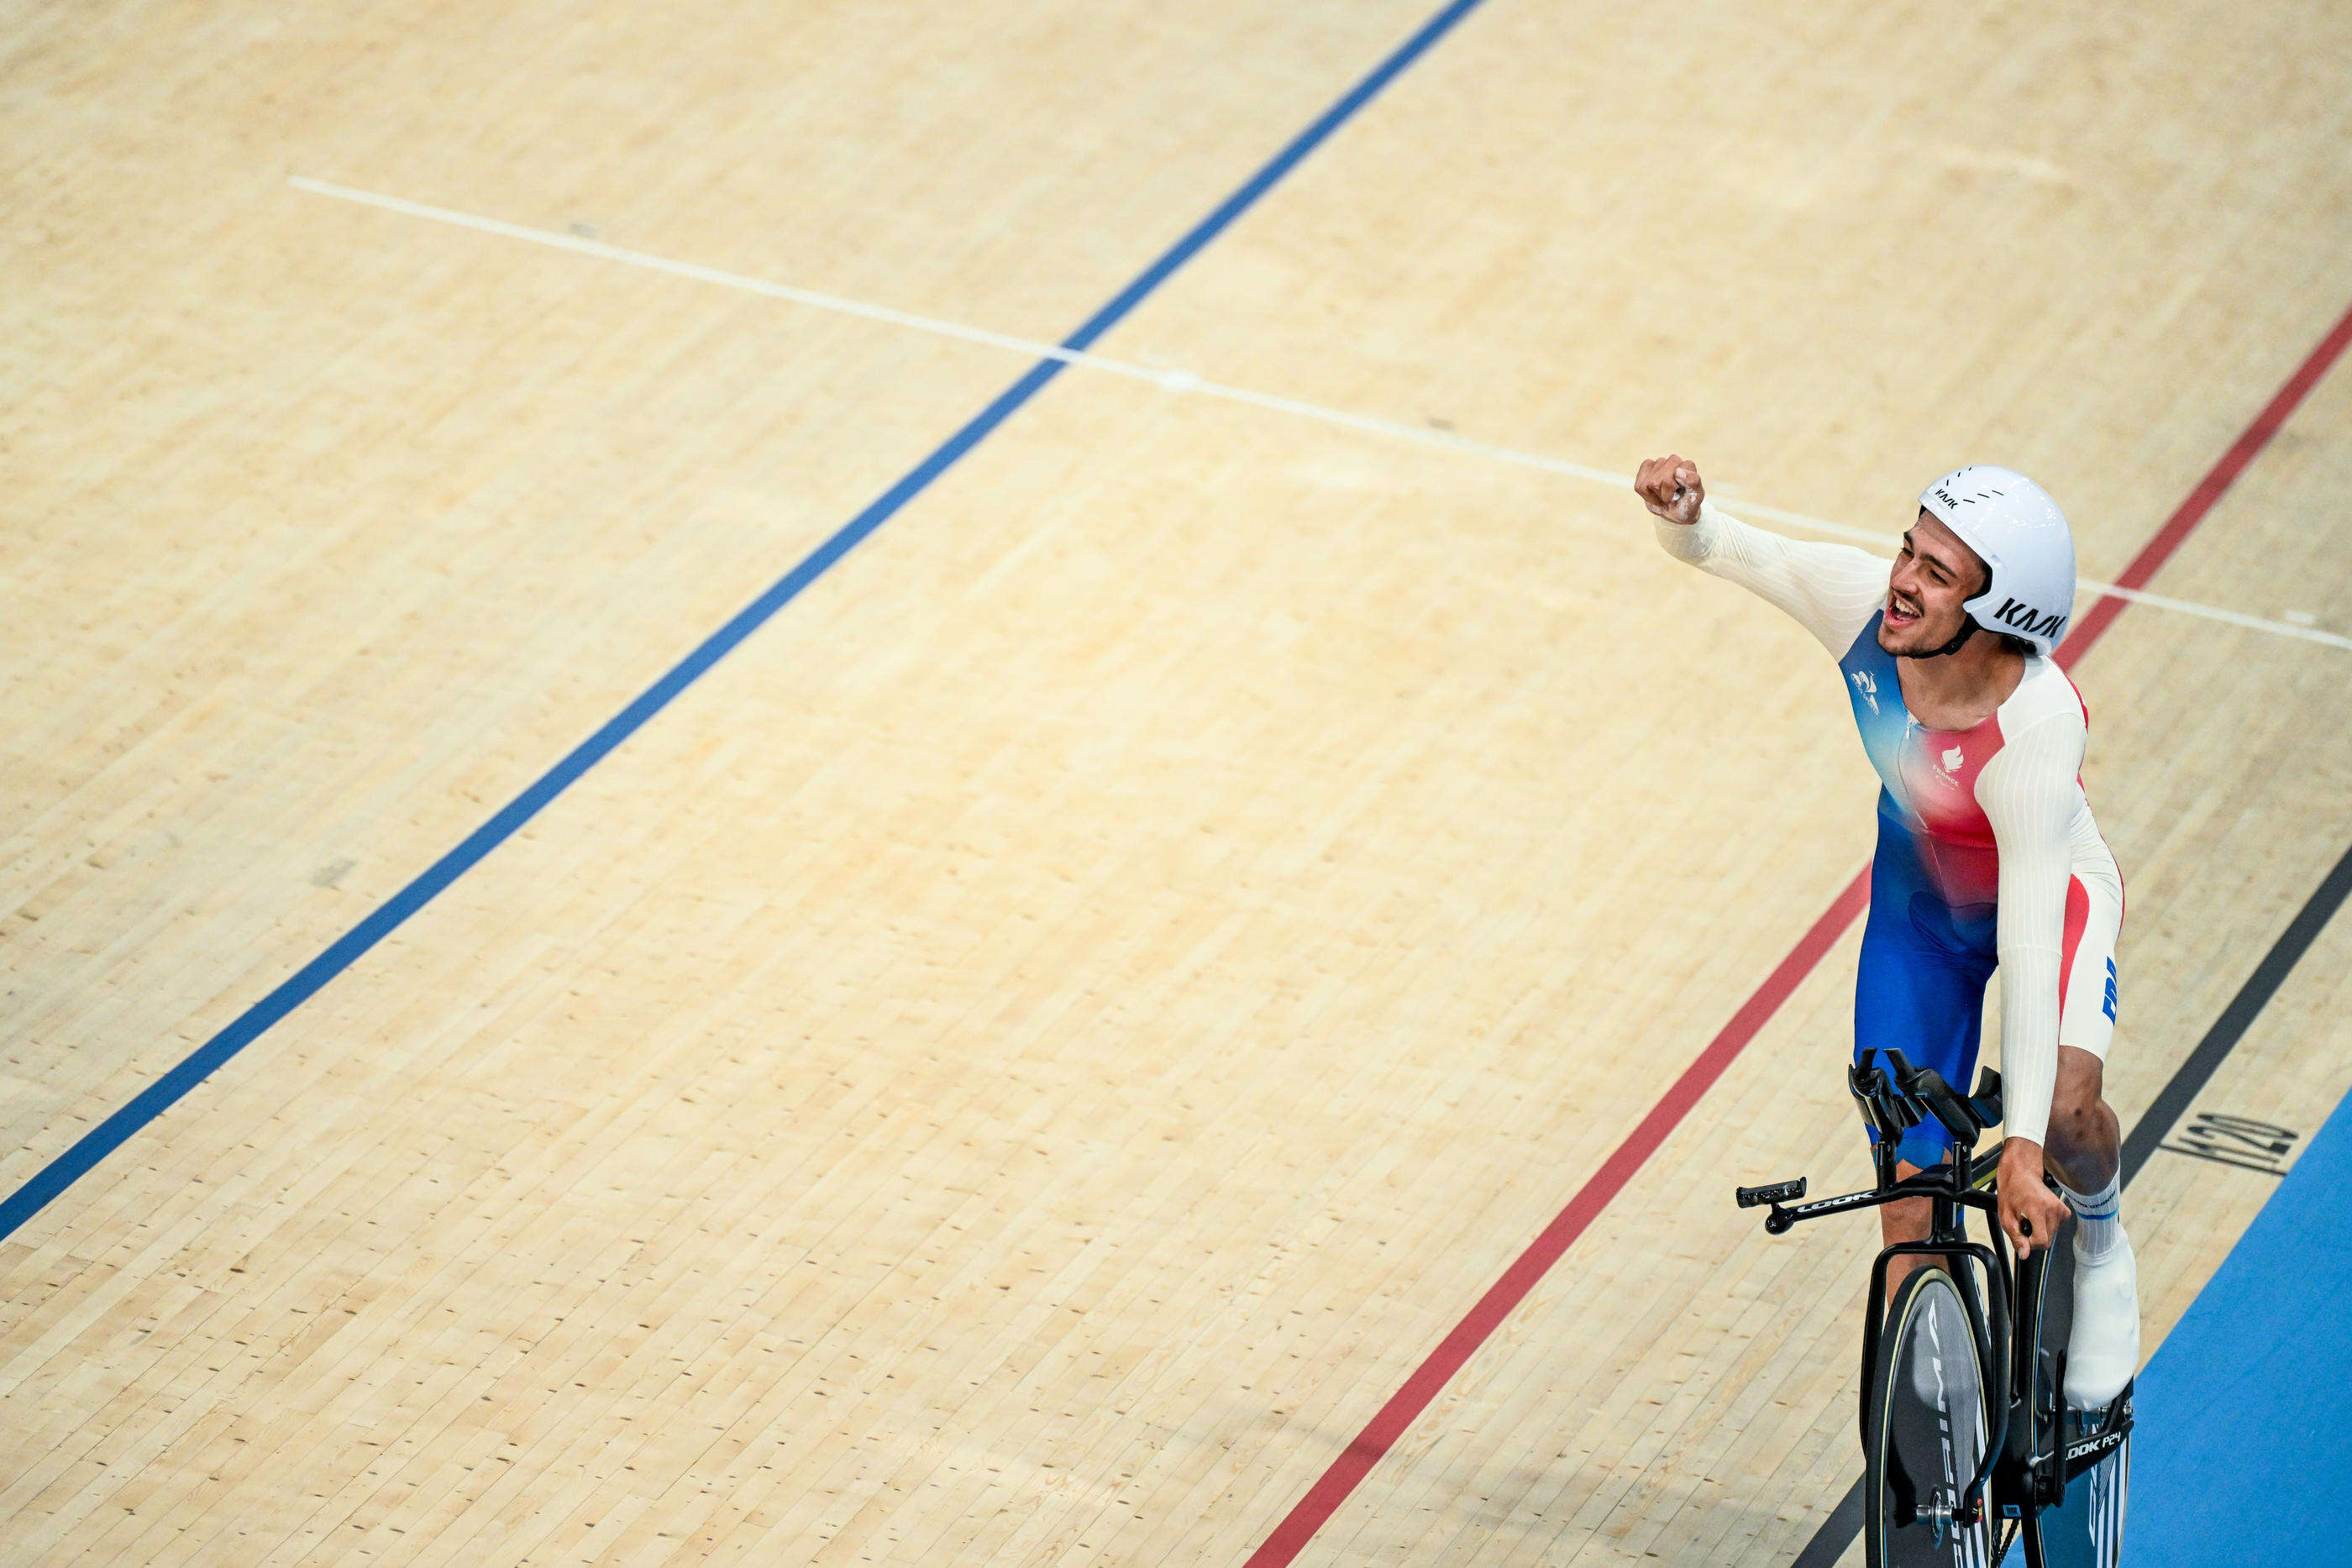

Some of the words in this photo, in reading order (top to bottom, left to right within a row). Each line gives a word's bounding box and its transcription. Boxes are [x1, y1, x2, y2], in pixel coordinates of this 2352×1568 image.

[1935, 488, 1958, 510] KASK
[1993, 597, 2066, 638] KASK
[2177, 1112, 2300, 1164] 120
[1797, 1191, 1874, 1214] LOOK
[2066, 1439, 2101, 1461] OOK
[2102, 1430, 2121, 1449] P24
